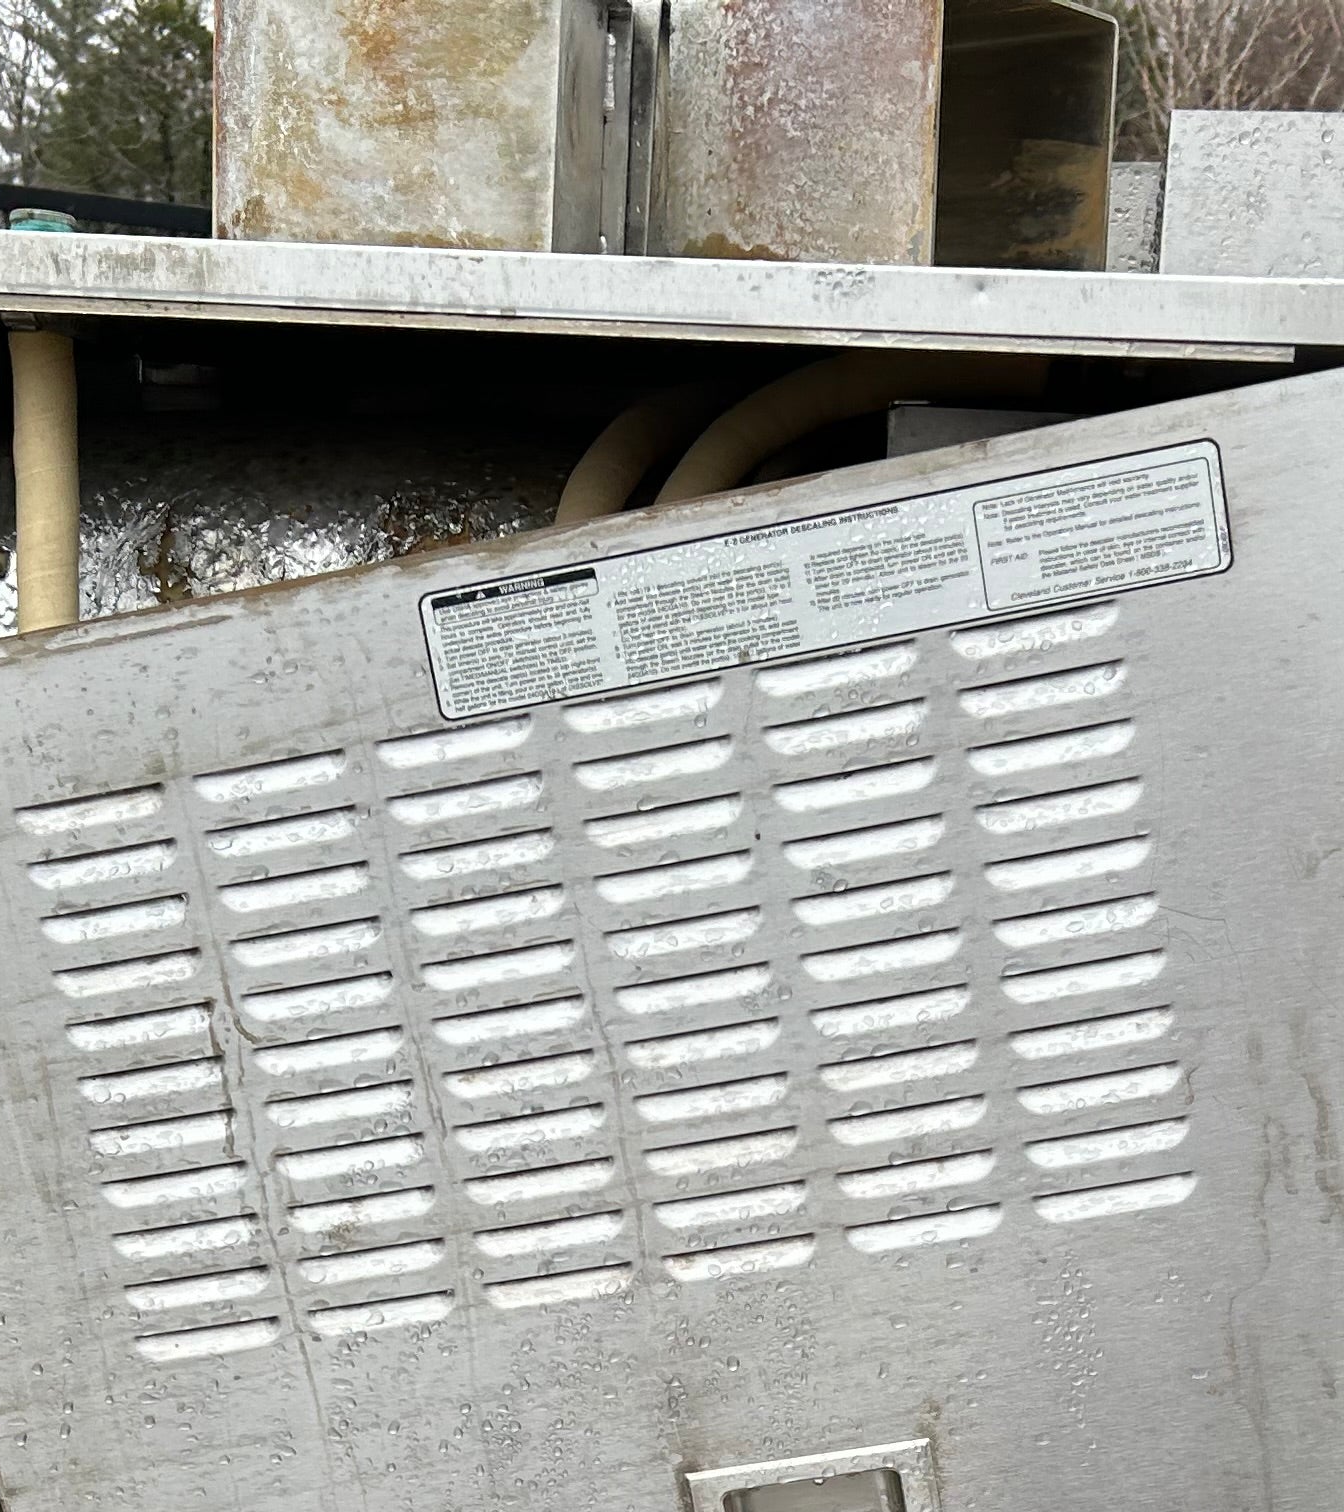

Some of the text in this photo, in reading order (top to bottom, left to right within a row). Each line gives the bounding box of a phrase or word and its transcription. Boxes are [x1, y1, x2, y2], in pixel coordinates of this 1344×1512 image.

[739, 527, 788, 544] GENERATOR
[790, 518, 836, 534] DESCALING
[838, 506, 898, 524] INSTRUCTIONS
[498, 579, 545, 594] WARNING
[1010, 586, 1051, 601] Cleveland
[1053, 579, 1091, 593] Customer
[1095, 573, 1125, 585] Service
